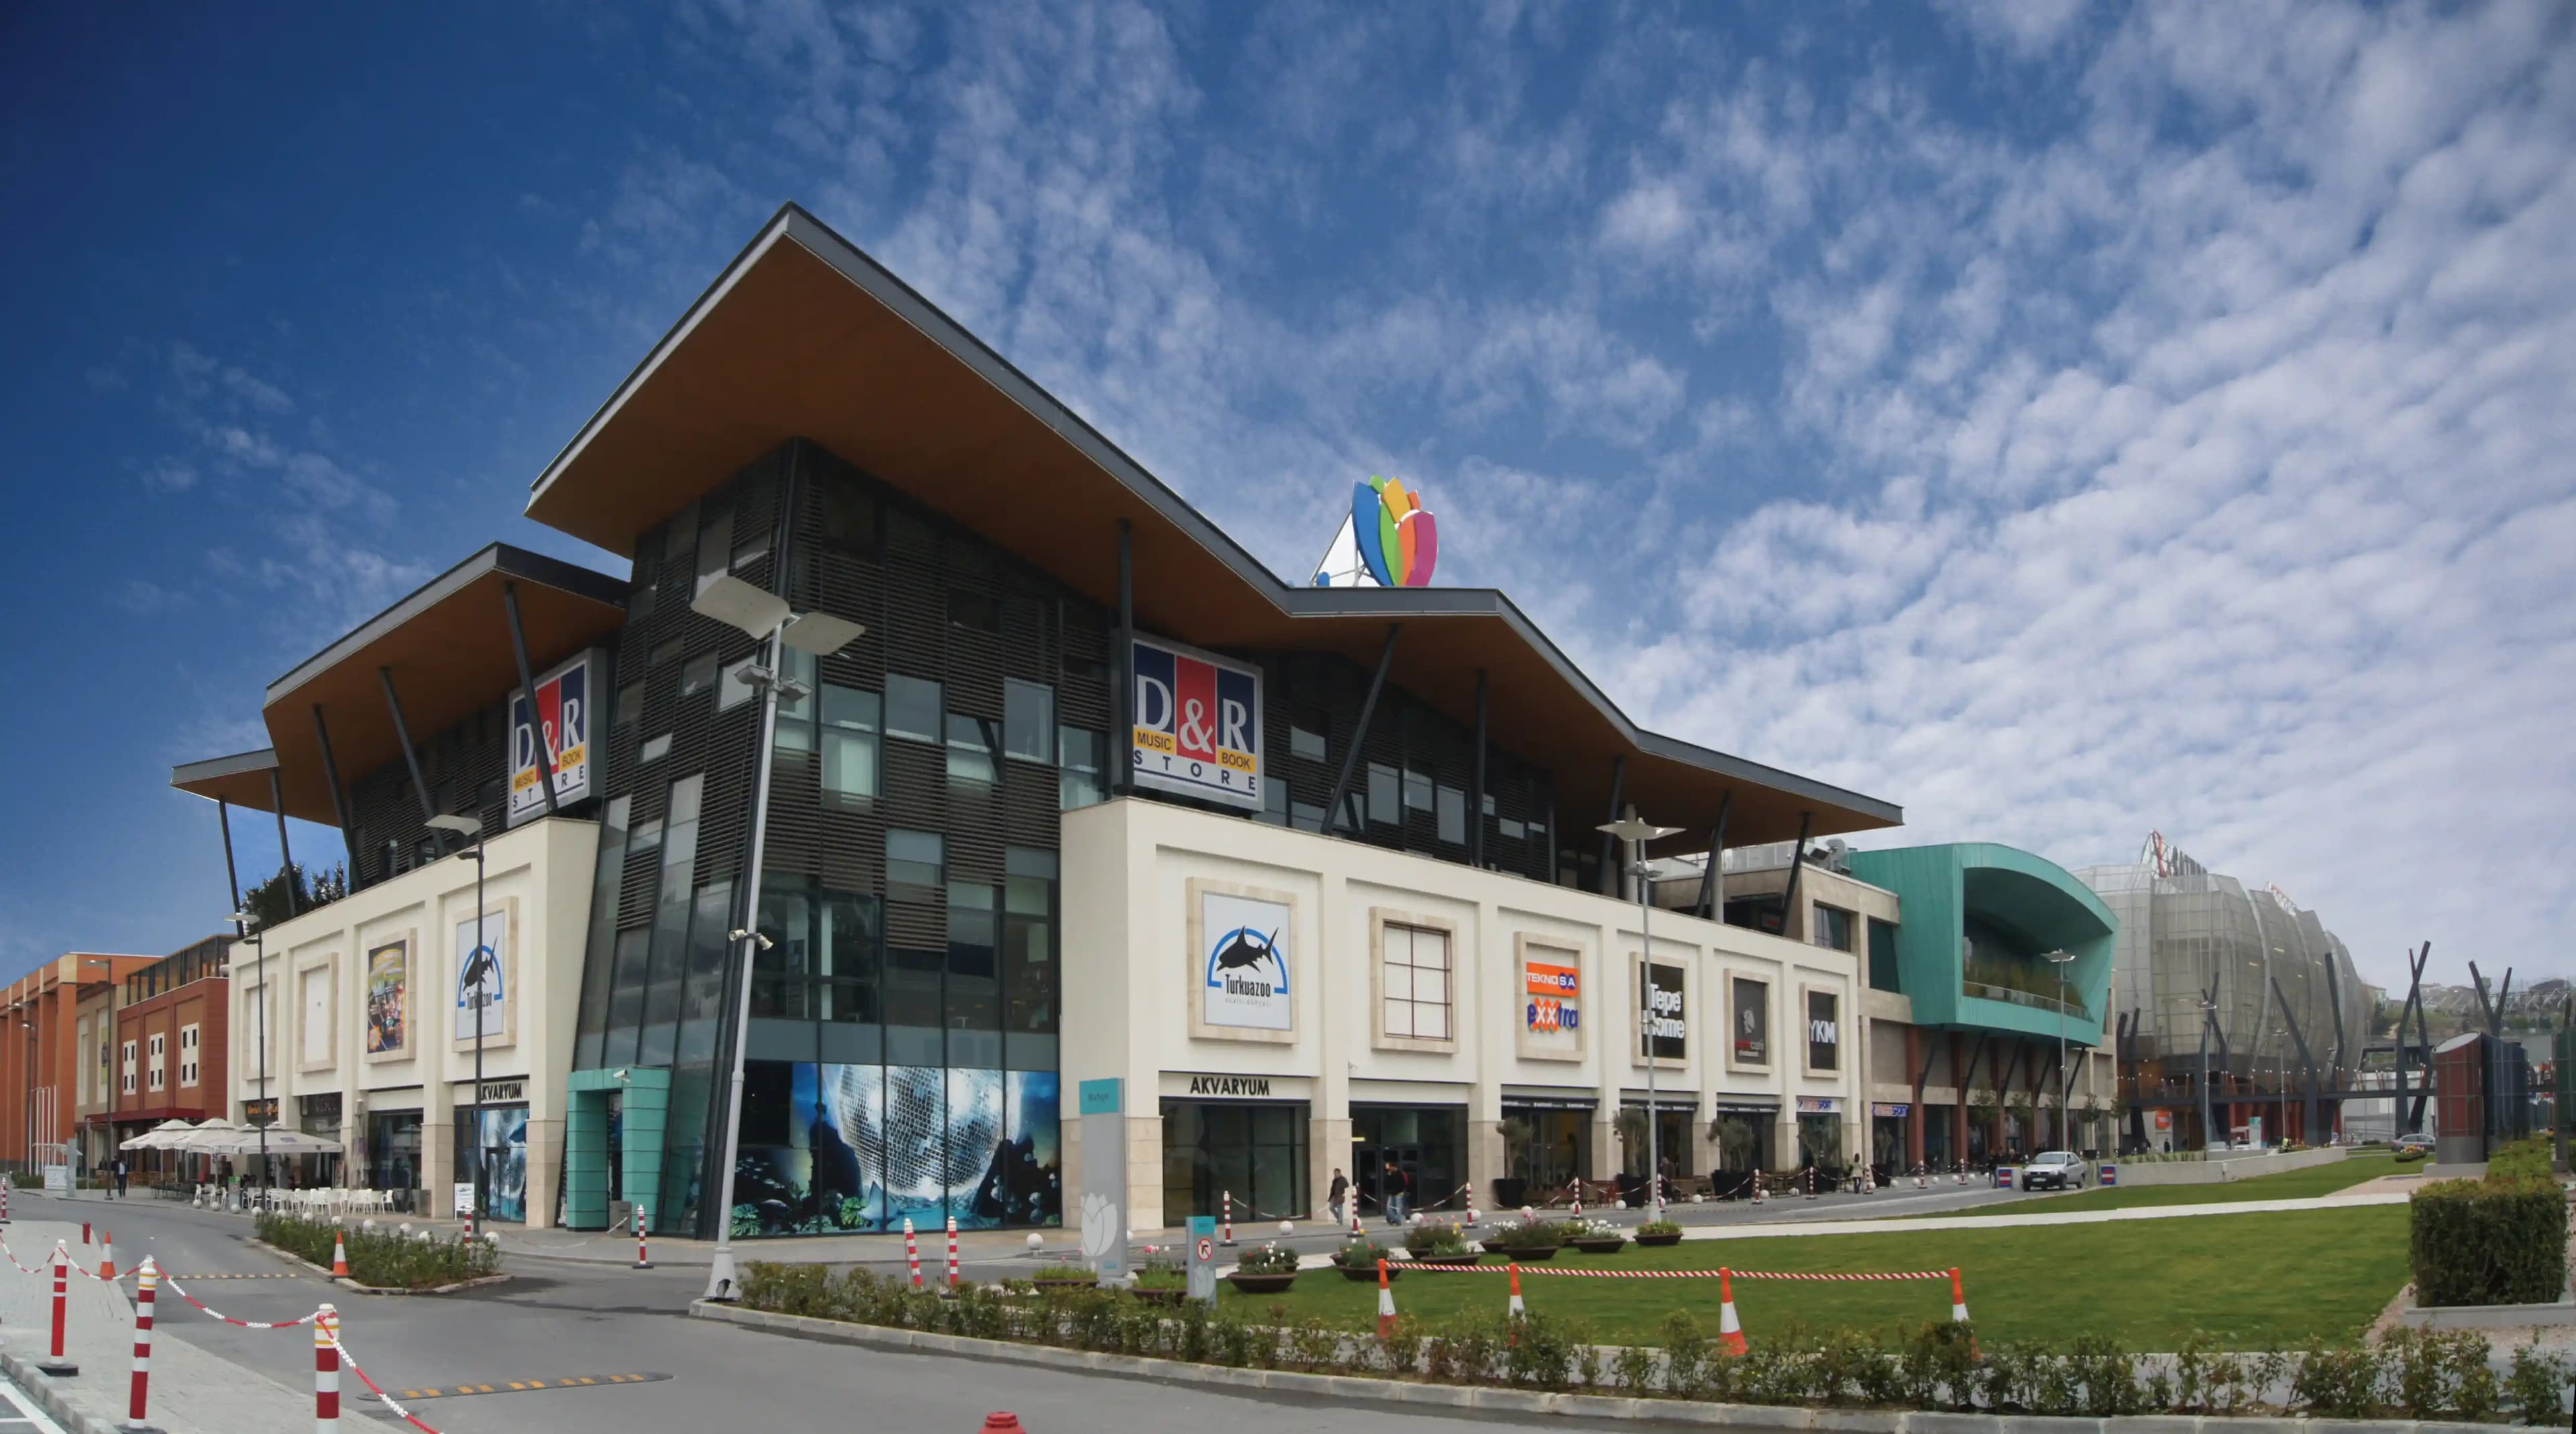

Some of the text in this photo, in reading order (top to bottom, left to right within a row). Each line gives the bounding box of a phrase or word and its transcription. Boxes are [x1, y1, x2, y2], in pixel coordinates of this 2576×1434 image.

[1136, 674, 1255, 754] D&R
[515, 698, 580, 773] D&R
[1137, 732, 1251, 769] MUSIC BOOK
[514, 751, 582, 788] MUSIC BOOK
[1134, 750, 1256, 790] STORE
[513, 765, 584, 808] STRE
[1225, 974, 1271, 997] Turkuazoo
[1526, 972, 1576, 988] TEKNOSA
[467, 992, 492, 1011] Turkzoo
[1650, 984, 1681, 1016] Tepe
[1527, 1003, 1578, 1028] exxtra
[1642, 1010, 1685, 1038] Home
[1809, 1019, 1836, 1043] YKM
[481, 1083, 522, 1100] KVARYUM
[1190, 1076, 1270, 1096] AKVARYUM
